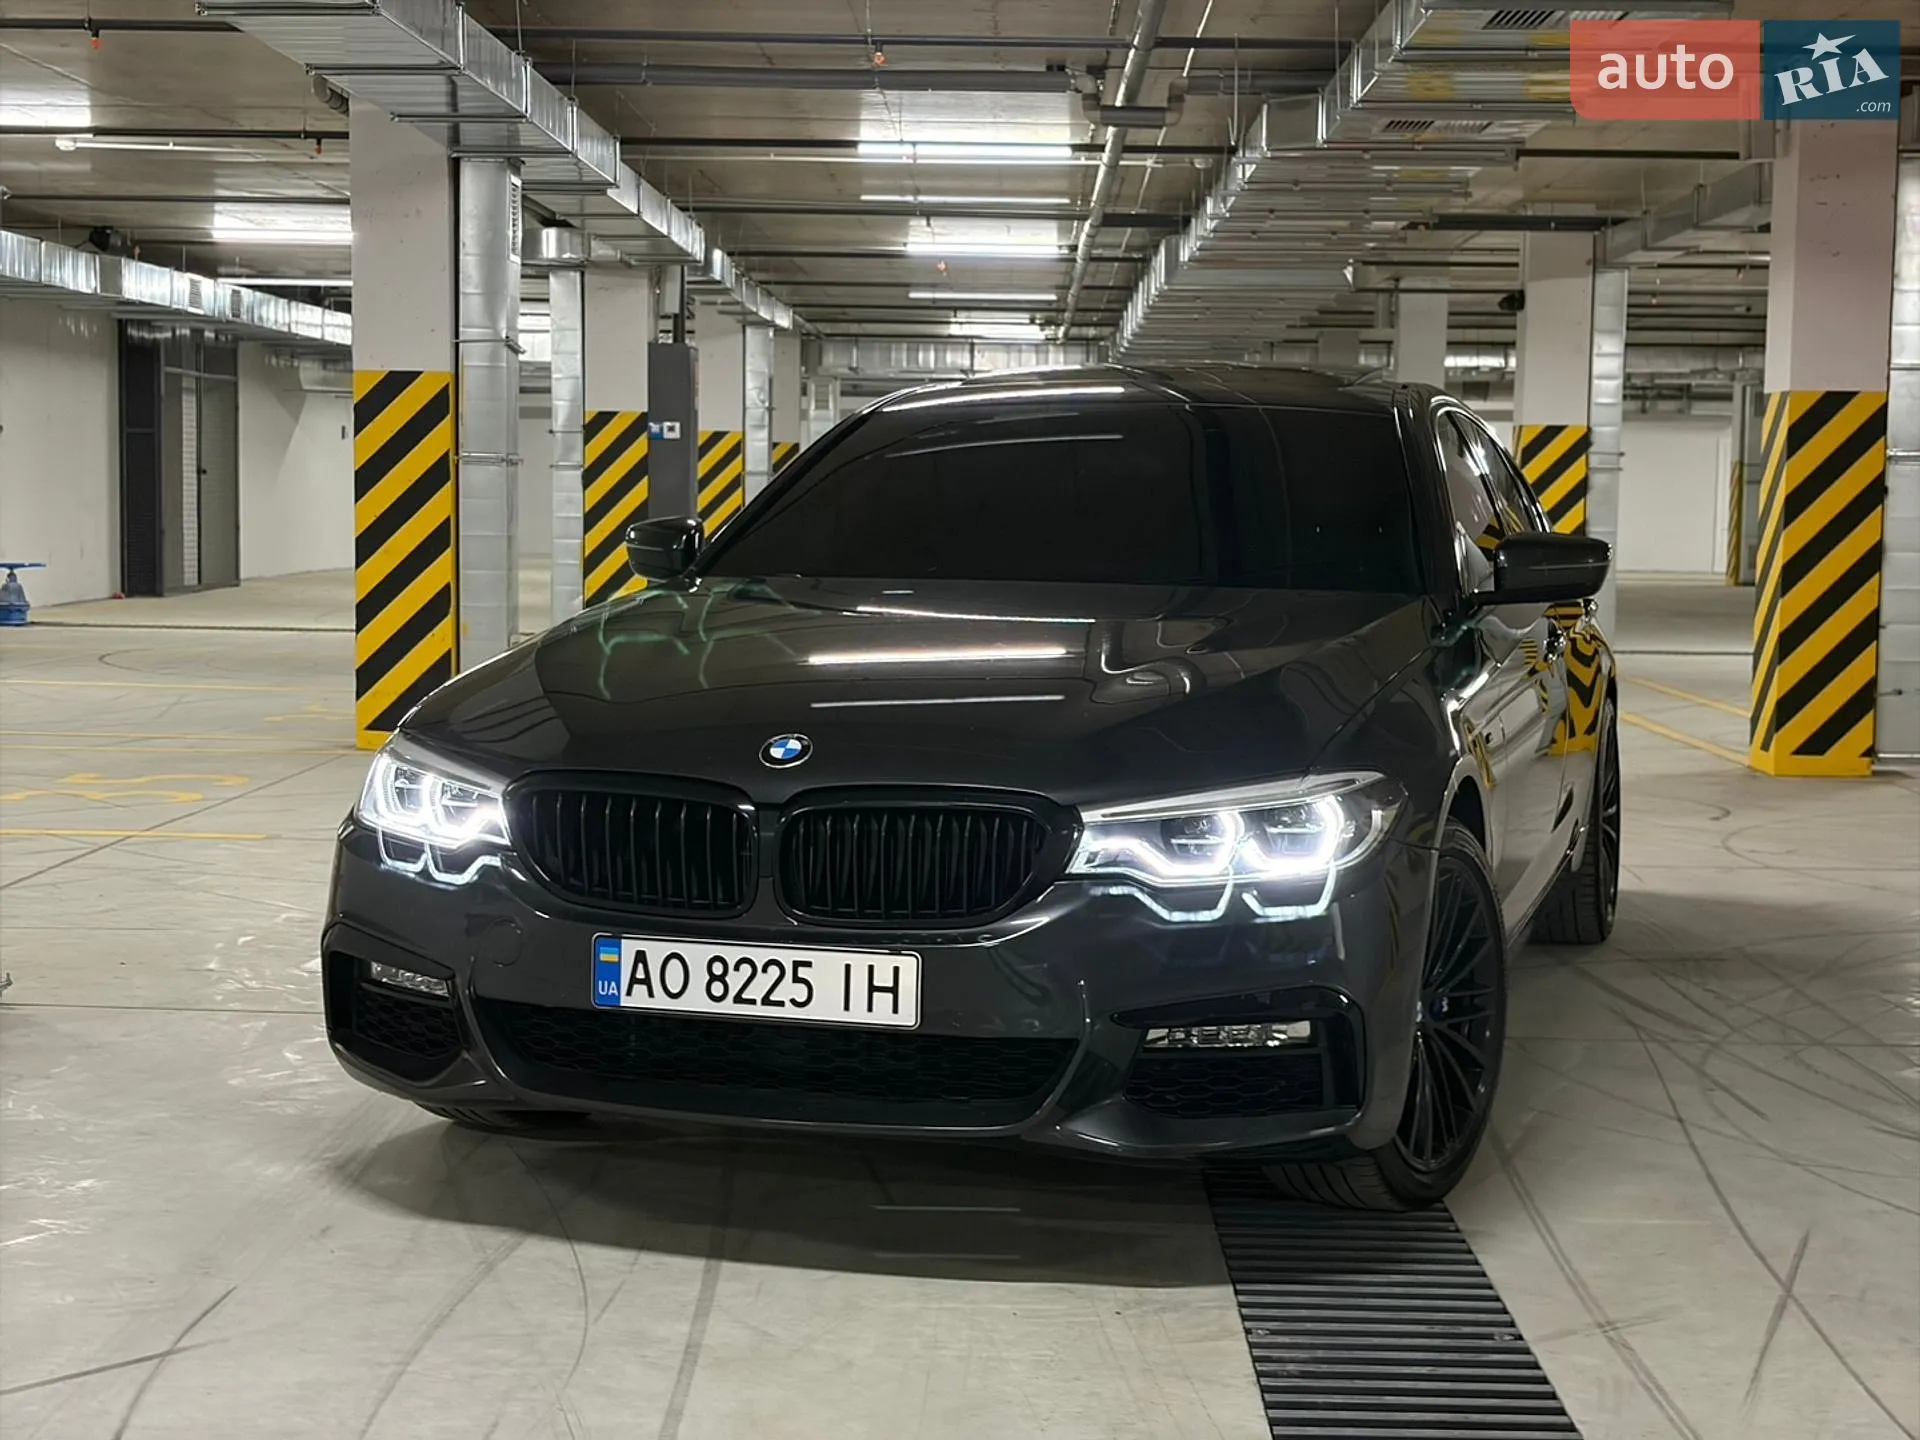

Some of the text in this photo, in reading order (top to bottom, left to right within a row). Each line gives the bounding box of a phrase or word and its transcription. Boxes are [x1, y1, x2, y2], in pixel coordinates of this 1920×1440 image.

[598, 979, 618, 996] UA
[625, 949, 899, 1015] AO 8225 IH
